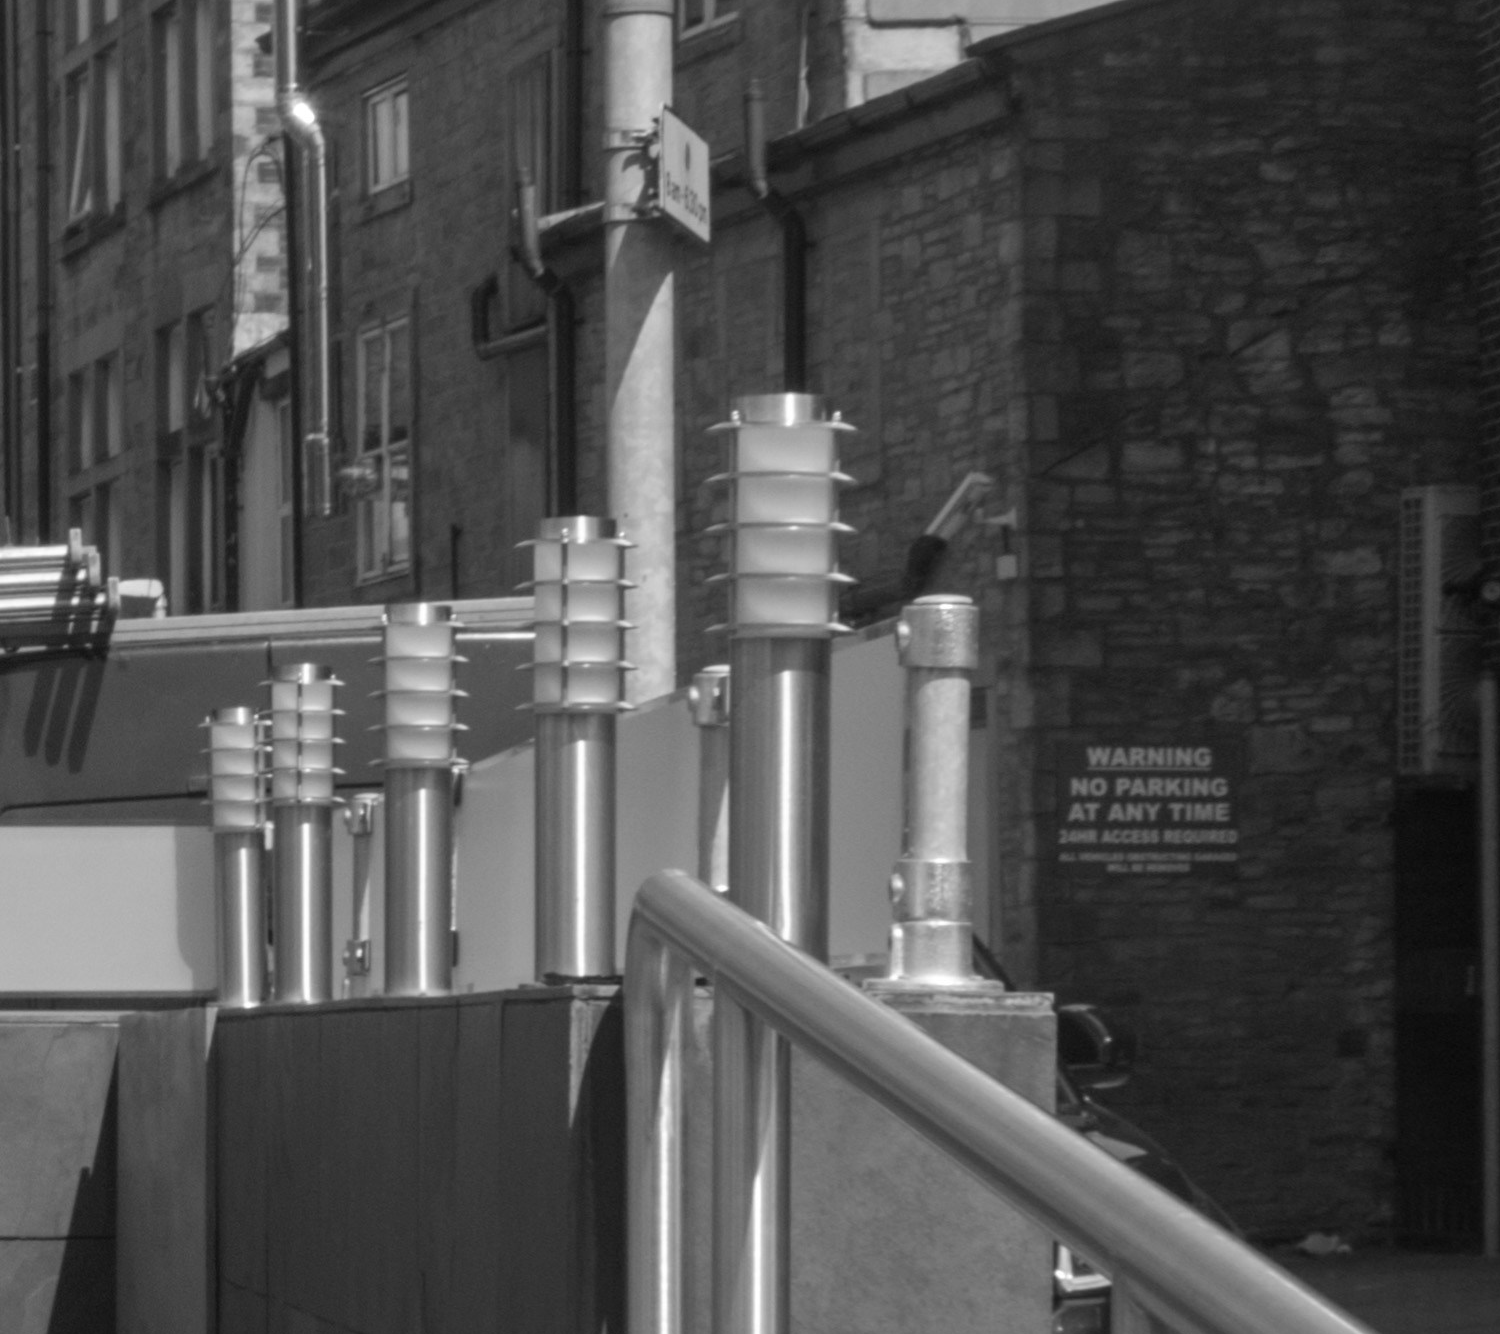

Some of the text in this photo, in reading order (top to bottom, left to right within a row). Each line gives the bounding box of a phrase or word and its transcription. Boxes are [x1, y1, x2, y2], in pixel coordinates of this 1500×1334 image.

[1086, 746, 1212, 767] WARNING
[1069, 777, 1229, 797] NO PARKING
[1067, 801, 1231, 822] AT ANY TIME
